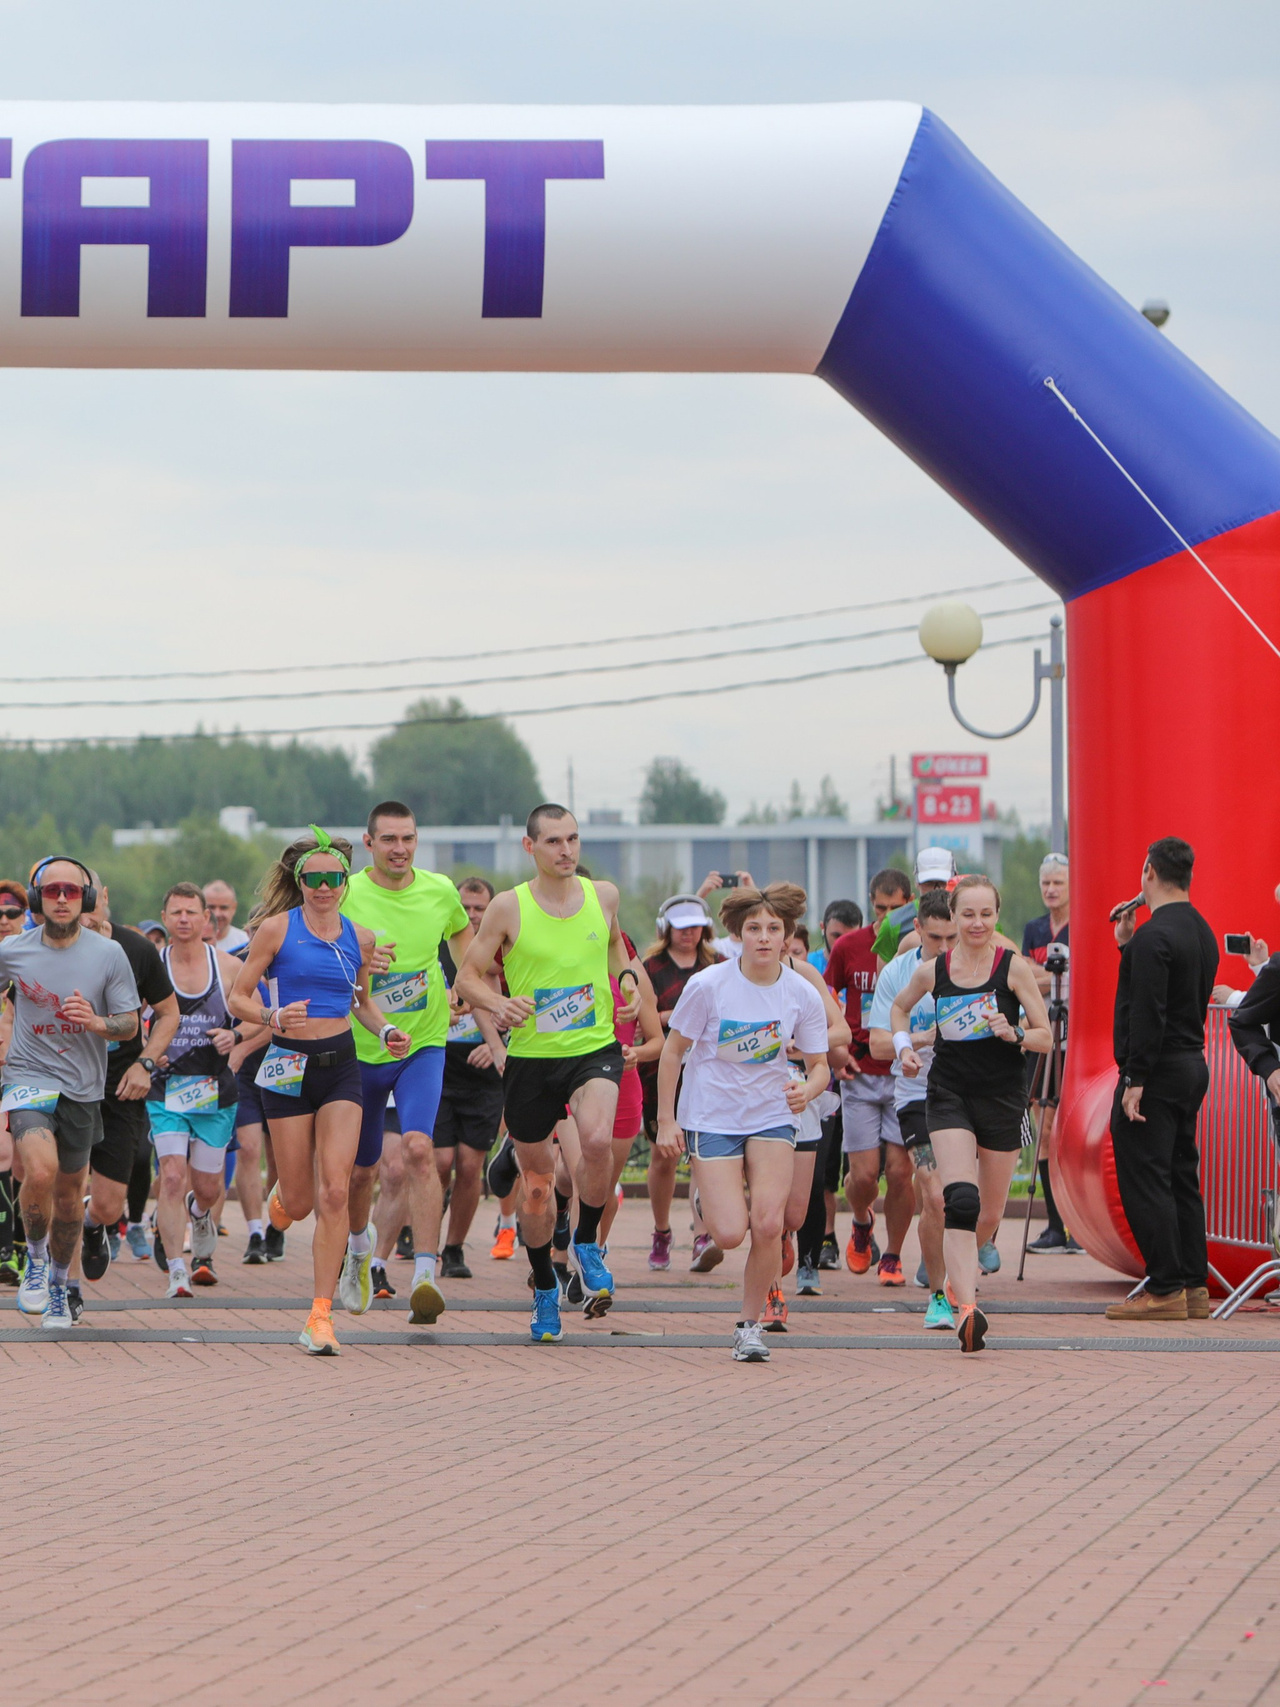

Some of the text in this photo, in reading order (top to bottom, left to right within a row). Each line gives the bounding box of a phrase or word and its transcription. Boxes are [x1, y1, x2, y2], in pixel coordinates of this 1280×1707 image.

[854, 971, 878, 991] CHA
[385, 985, 413, 1005] 166
[190, 1014, 216, 1023] CALM
[550, 1000, 579, 1023] 146
[954, 1010, 977, 1031] 33
[32, 1024, 56, 1035] WE
[181, 1026, 201, 1036] AND
[170, 1038, 213, 1048] EEP GOIN
[737, 1037, 761, 1052] 42
[264, 1063, 285, 1079] 128
[12, 1086, 40, 1101] 129
[178, 1087, 203, 1105] 132
